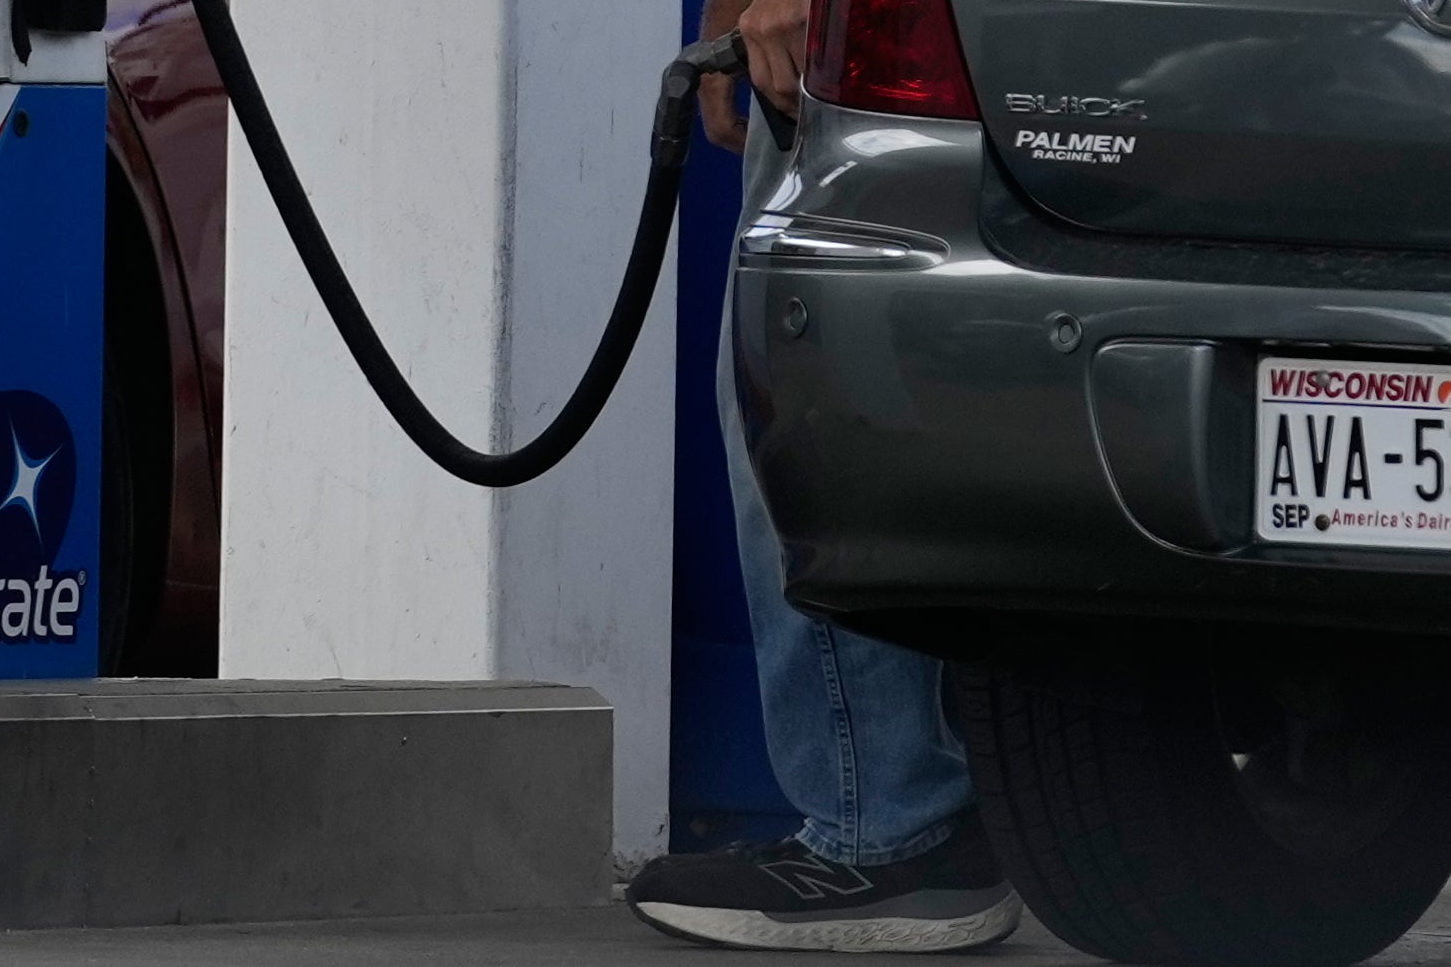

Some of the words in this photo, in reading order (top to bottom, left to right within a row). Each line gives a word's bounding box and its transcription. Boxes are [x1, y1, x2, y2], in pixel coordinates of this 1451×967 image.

[1005, 93, 1148, 120] BUICK
[1015, 129, 1137, 154] PALMEN
[1032, 149, 1098, 164] RACINE,
[1101, 153, 1122, 164] WI
[1270, 368, 1434, 403] WISCONSIN
[1269, 413, 1445, 503] AVA-5
[1272, 503, 1311, 529] SEP
[1331, 508, 1413, 528] America's
